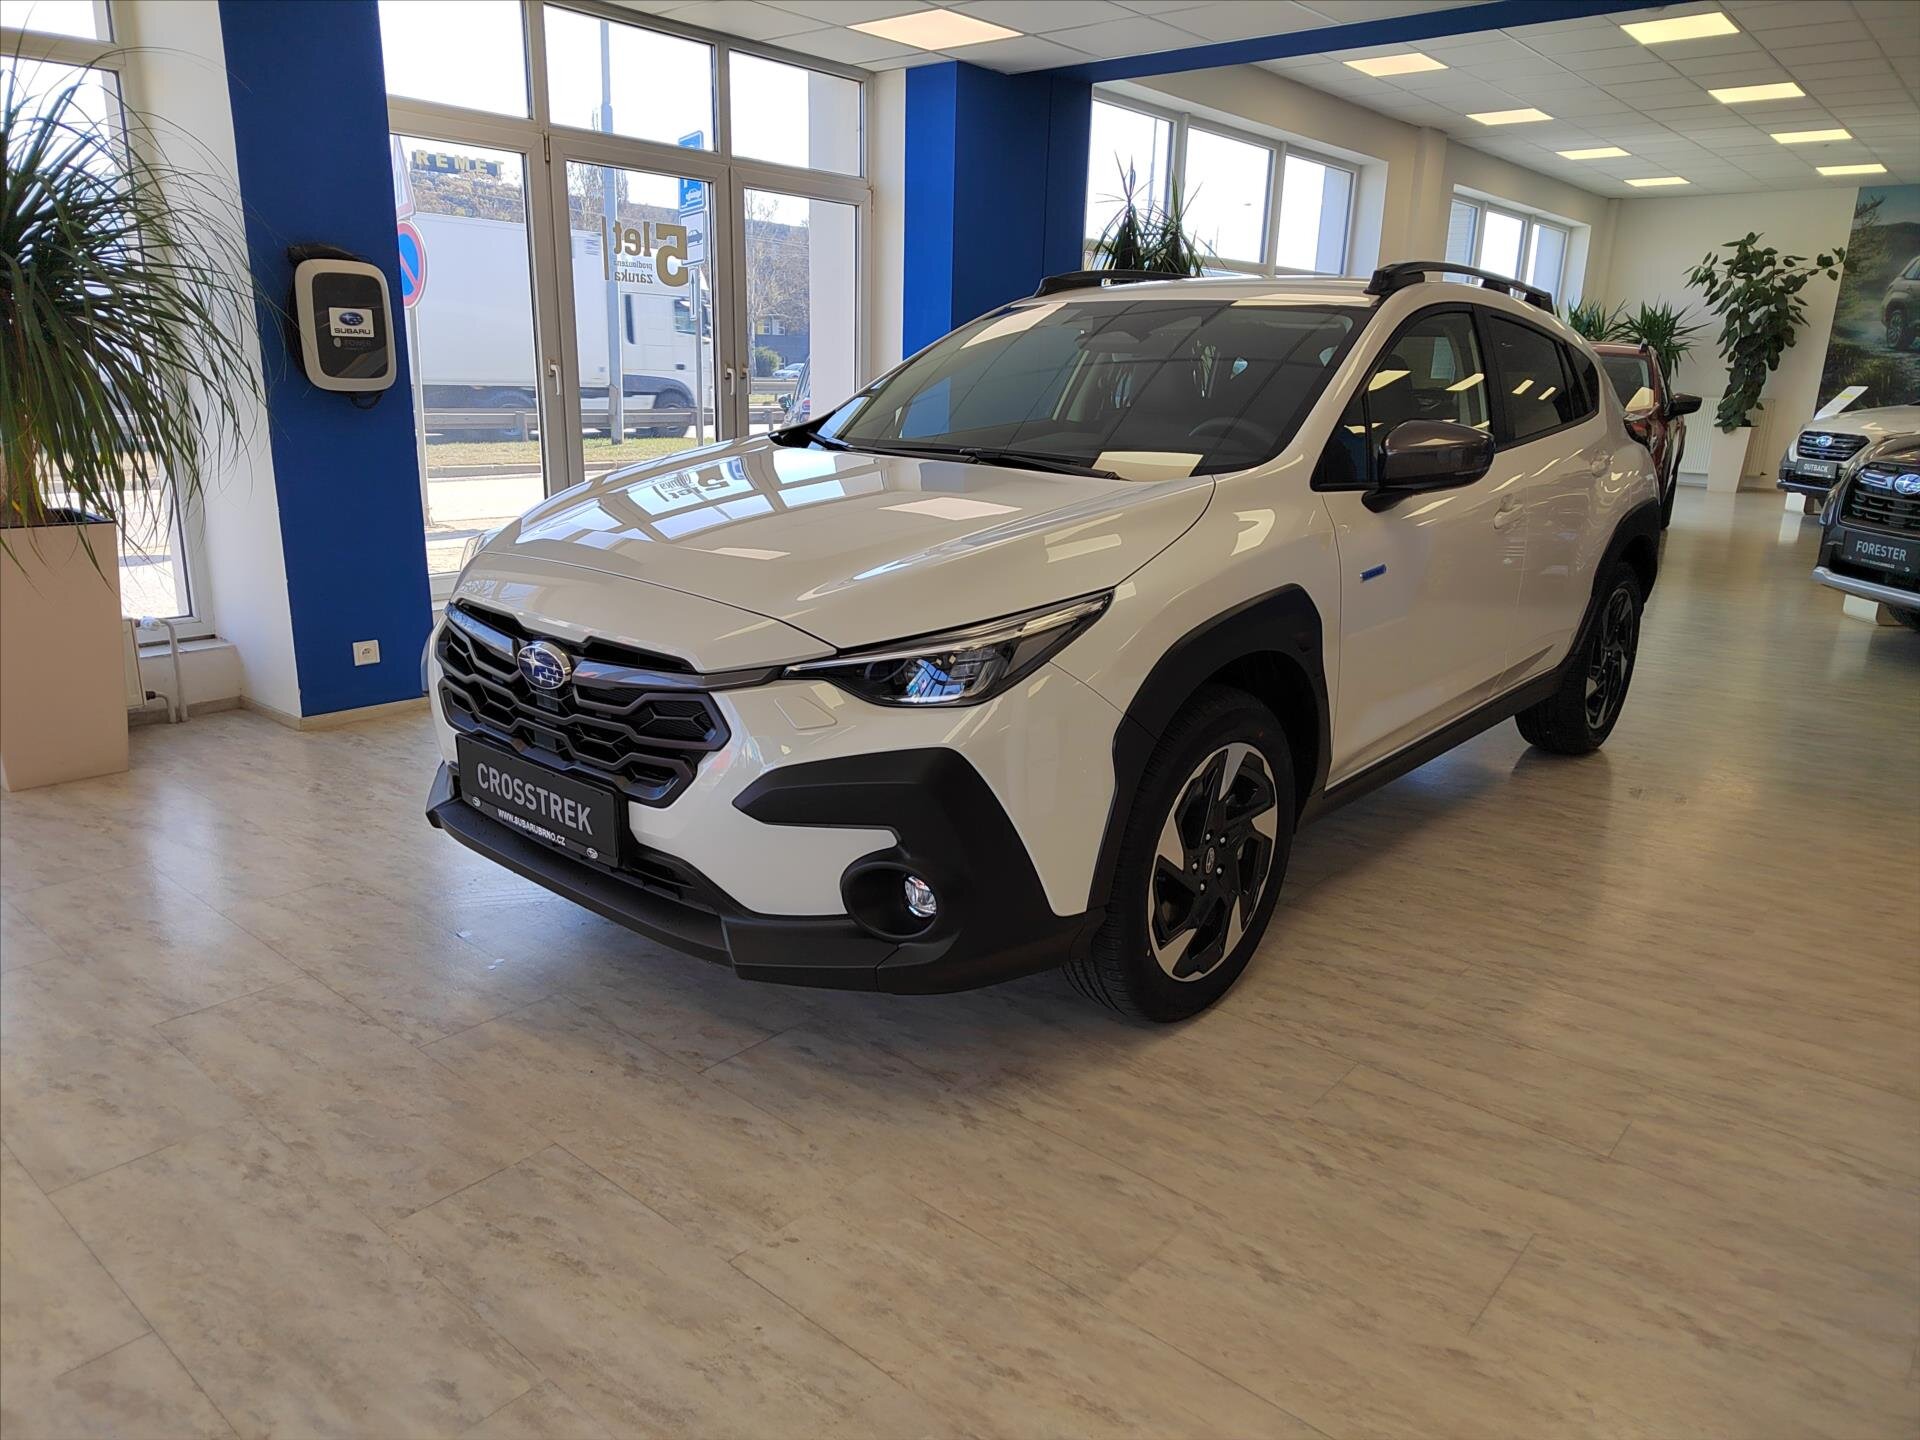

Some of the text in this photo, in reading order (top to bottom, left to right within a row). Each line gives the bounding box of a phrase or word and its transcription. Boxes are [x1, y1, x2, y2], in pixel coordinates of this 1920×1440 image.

[416, 150, 504, 177] REMET
[334, 327, 371, 335] SUBARU
[1803, 463, 1828, 473] OUTBACK
[1856, 540, 1907, 562] FORESTER
[477, 762, 593, 836] CROSSTREK
[497, 808, 566, 846] WWW.SUBARUBRNO.CZ
